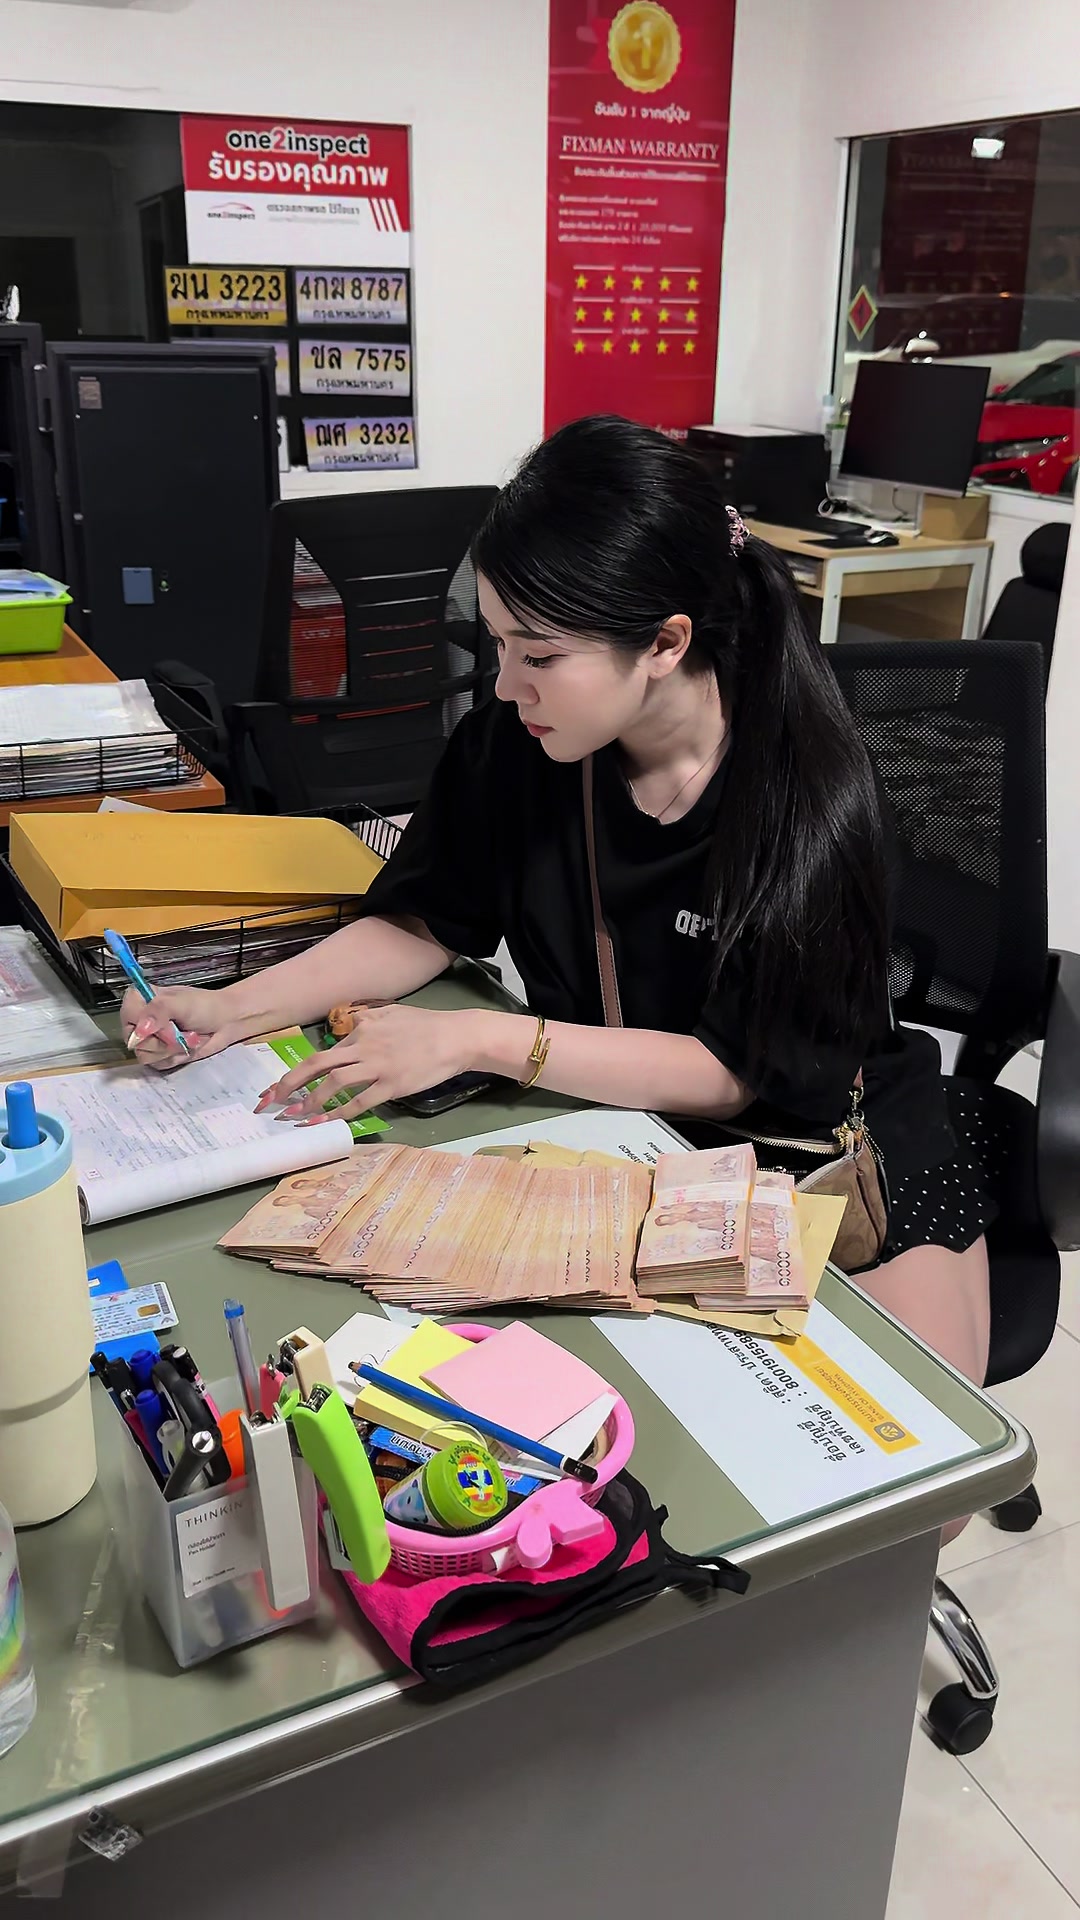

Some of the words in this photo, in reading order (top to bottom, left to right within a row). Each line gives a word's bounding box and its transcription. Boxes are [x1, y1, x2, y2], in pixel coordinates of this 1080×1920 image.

[228, 129, 368, 158] one2inspect
[562, 135, 626, 155] FIXMAN
[630, 139, 719, 160] WARRANTY
[208, 151, 389, 191] รับรองคุณภาพ
[220, 274, 281, 301] 3223
[351, 277, 403, 301] 8787
[186, 309, 269, 322] กรุงเทพมหานคร
[355, 348, 406, 372] 7575
[360, 422, 409, 445] 3232
[797, 1420, 847, 1461] ชื่อบัญชี
[804, 1403, 866, 1455] เลขที่บัญชี
